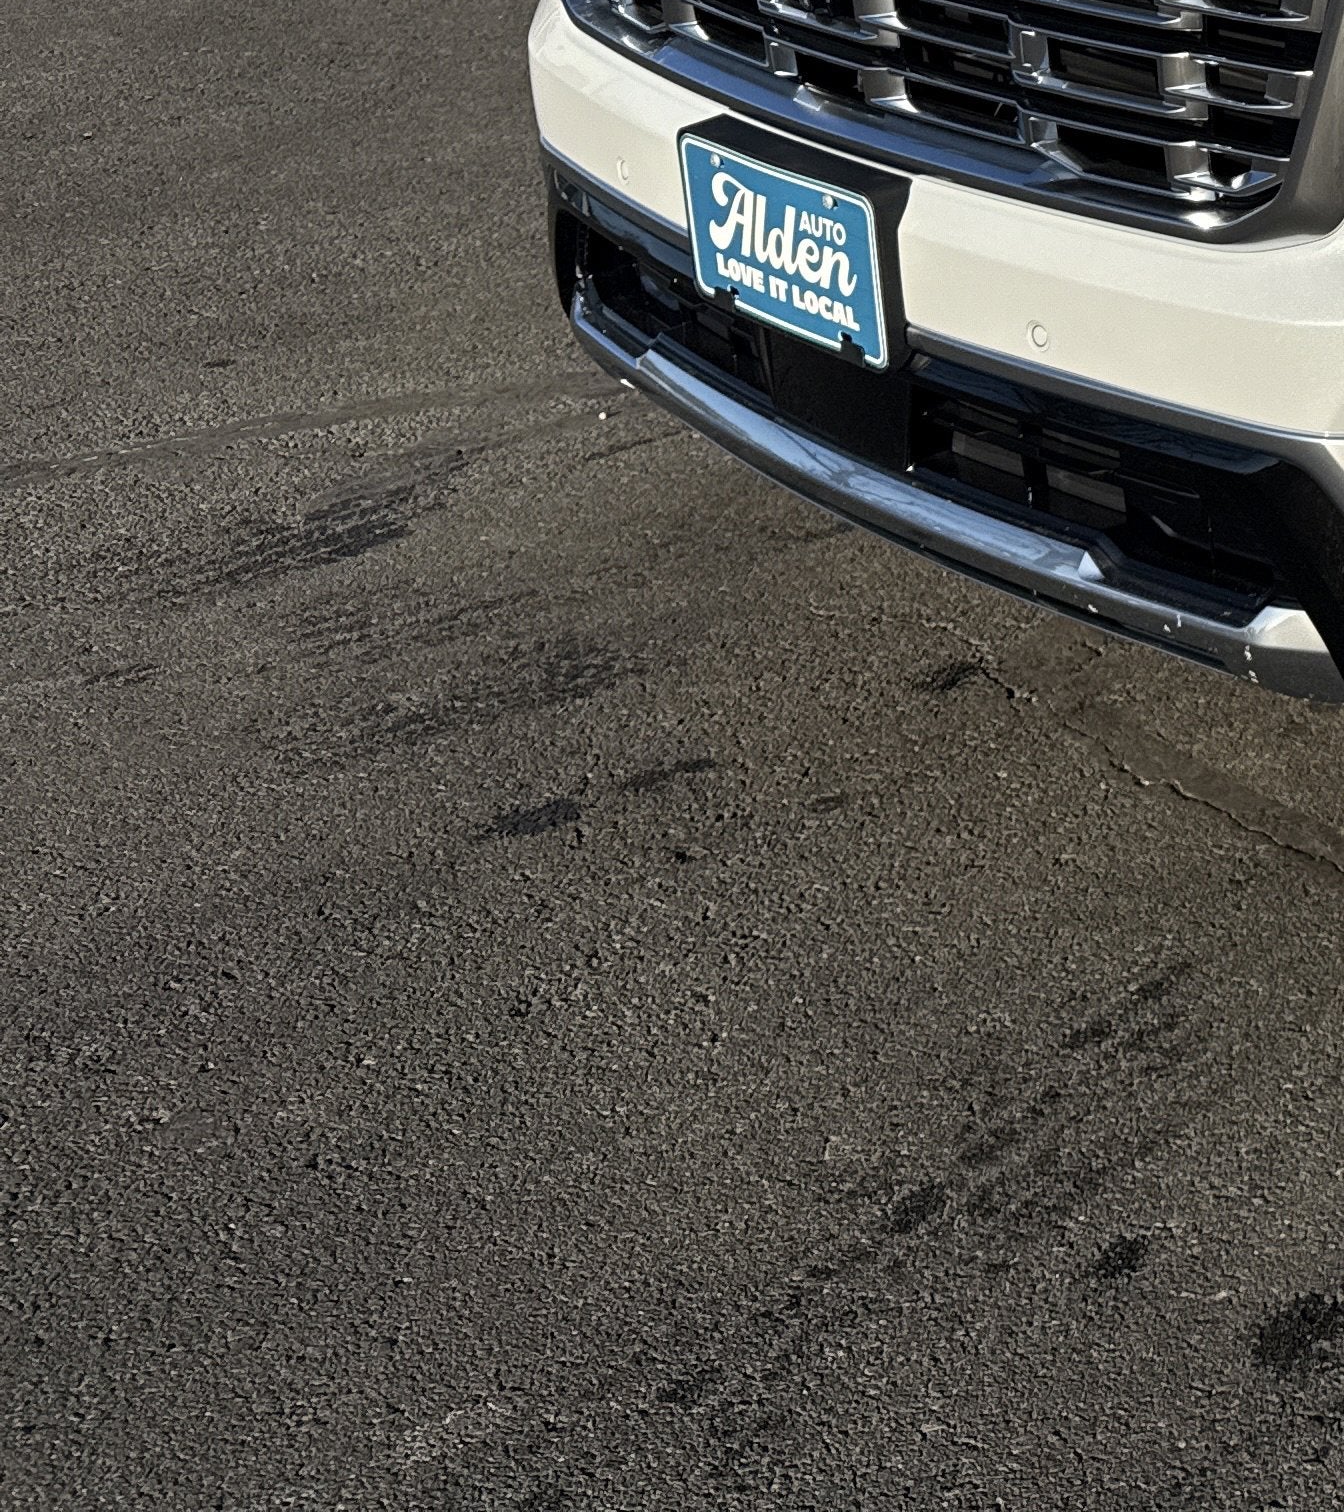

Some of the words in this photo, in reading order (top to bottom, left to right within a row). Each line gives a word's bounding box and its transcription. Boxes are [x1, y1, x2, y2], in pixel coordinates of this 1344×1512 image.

[709, 172, 858, 297] Alden
[799, 211, 846, 246] AUTO
[717, 252, 766, 294] LOVE
[769, 274, 788, 303] IT
[792, 285, 861, 332] LOCAL
